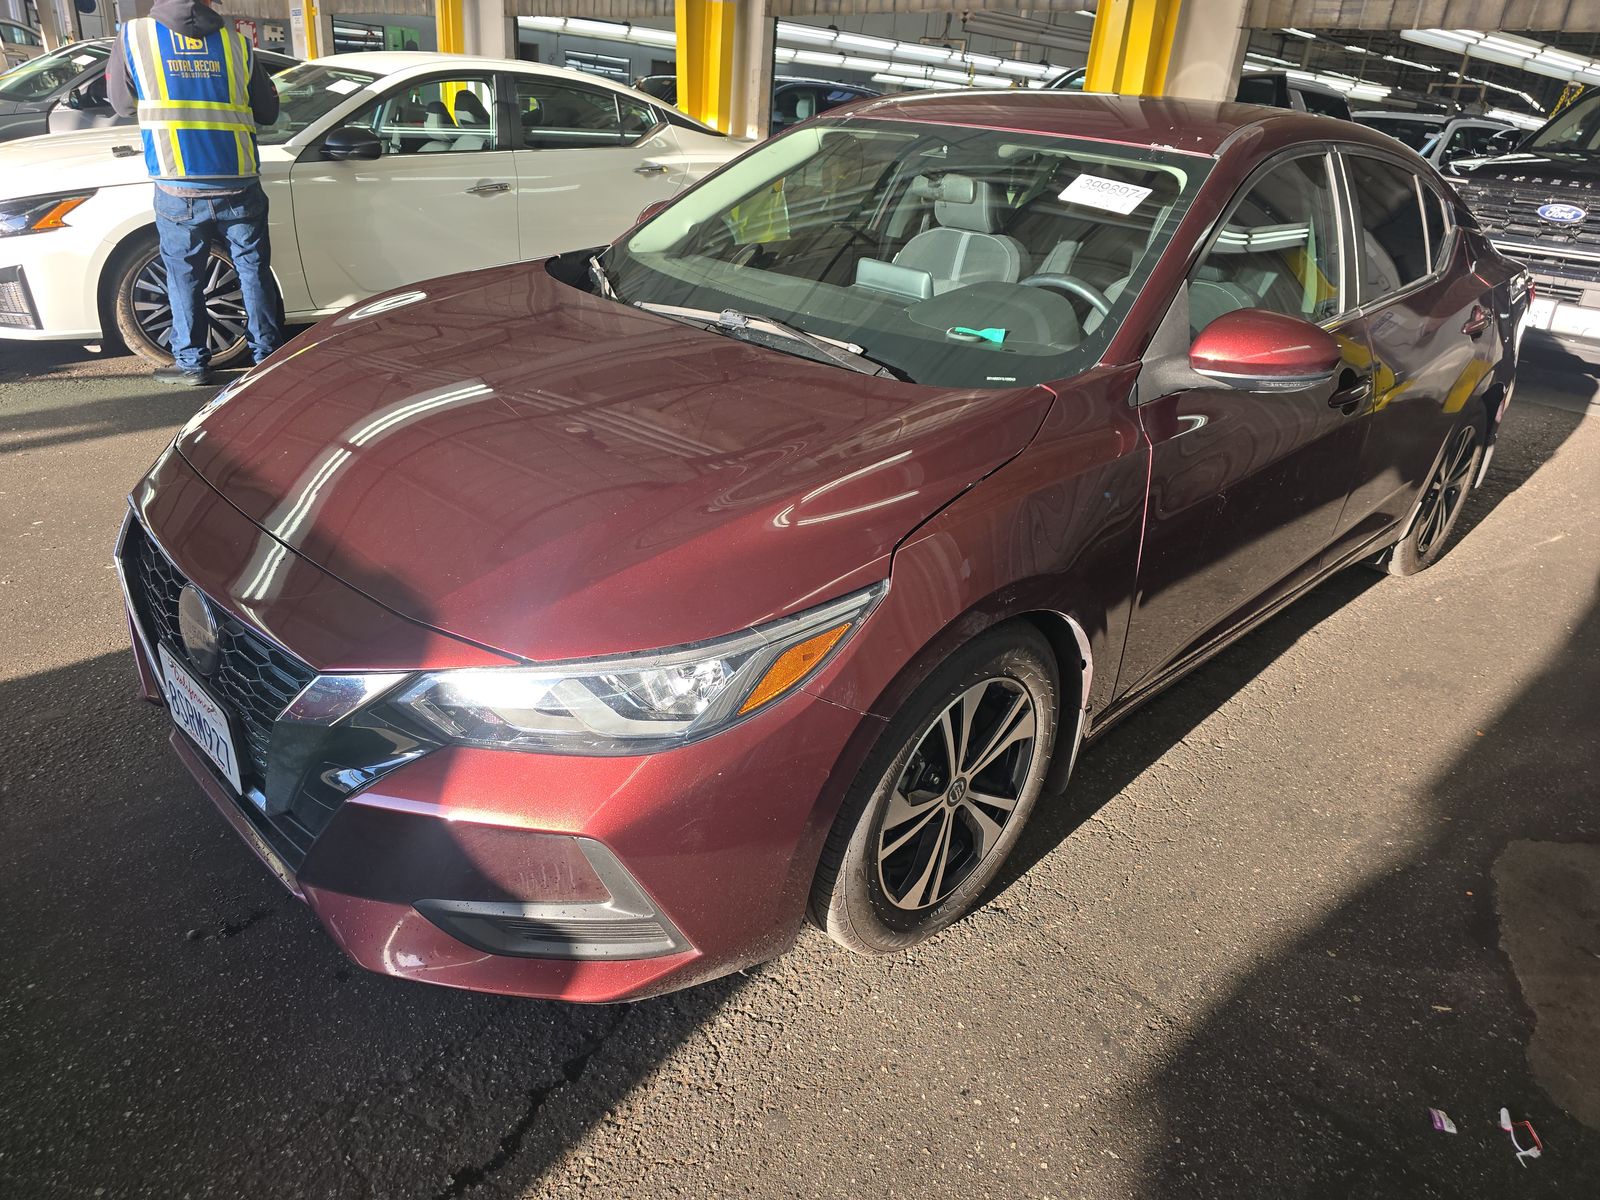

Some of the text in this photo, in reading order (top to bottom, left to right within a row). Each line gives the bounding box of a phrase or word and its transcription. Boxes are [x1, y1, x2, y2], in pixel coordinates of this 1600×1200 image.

[167, 60, 220, 73] TOTAL RECON
[1543, 206, 1578, 219] Ford
[169, 680, 231, 775] 8SRM927
